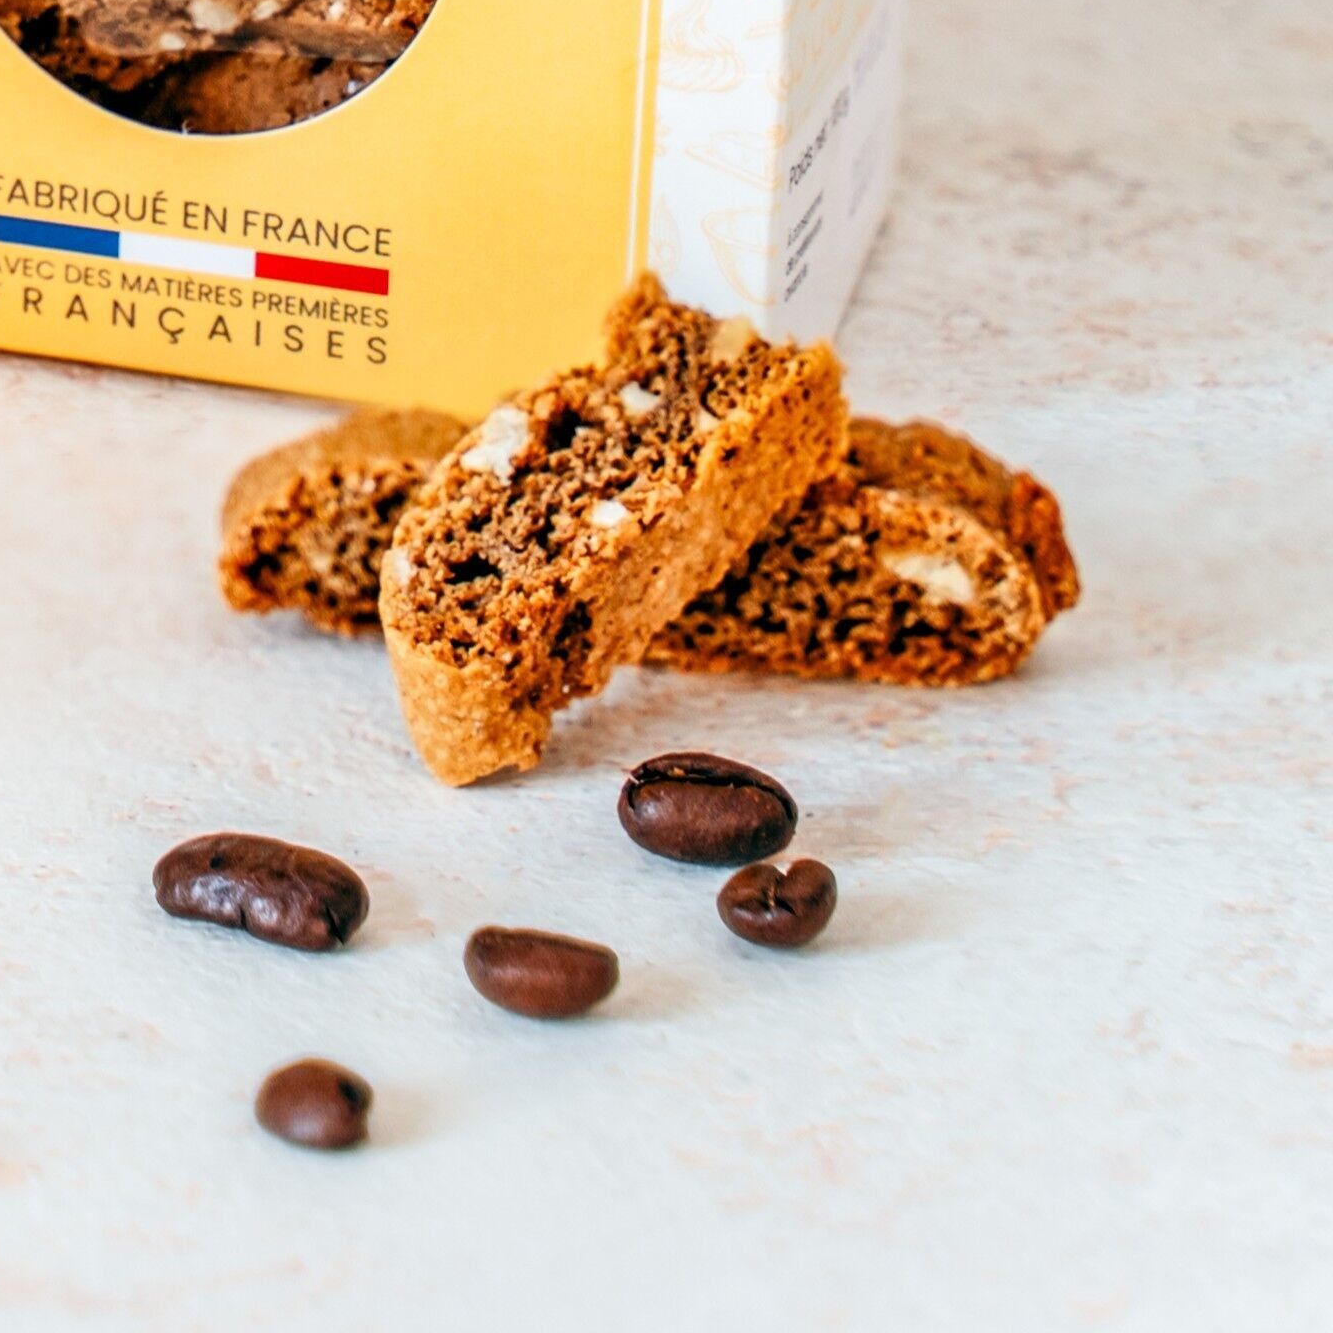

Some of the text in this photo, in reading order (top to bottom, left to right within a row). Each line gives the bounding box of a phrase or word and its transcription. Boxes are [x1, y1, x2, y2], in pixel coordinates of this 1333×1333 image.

[182, 201, 228, 234] EN
[243, 209, 393, 257] FRANCE
[64, 263, 112, 290] DES
[120, 271, 244, 309] MATIÈRES
[251, 290, 390, 329] PREMIÈRES
